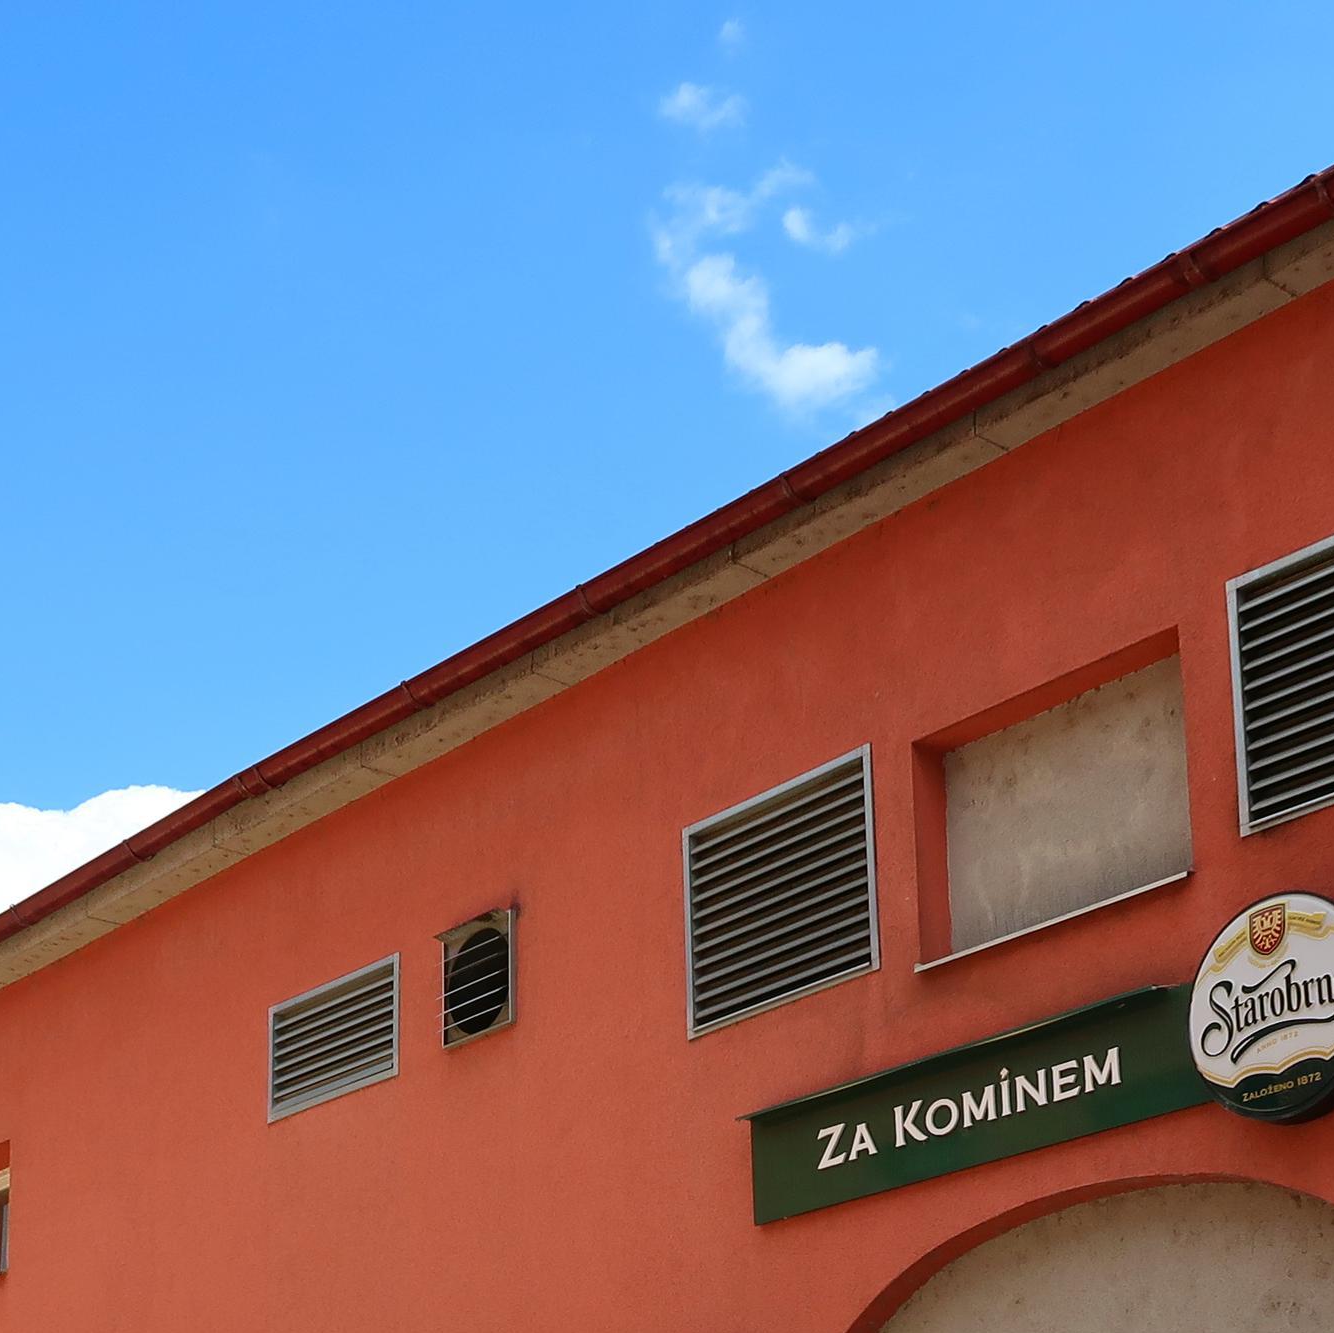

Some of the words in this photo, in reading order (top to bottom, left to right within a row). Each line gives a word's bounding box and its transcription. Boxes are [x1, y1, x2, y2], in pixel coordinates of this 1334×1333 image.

[1280, 1030, 1299, 1041] 1872
[1242, 1080, 1294, 1102] ZALOŽENO
[1296, 1071, 1322, 1086] 1872
